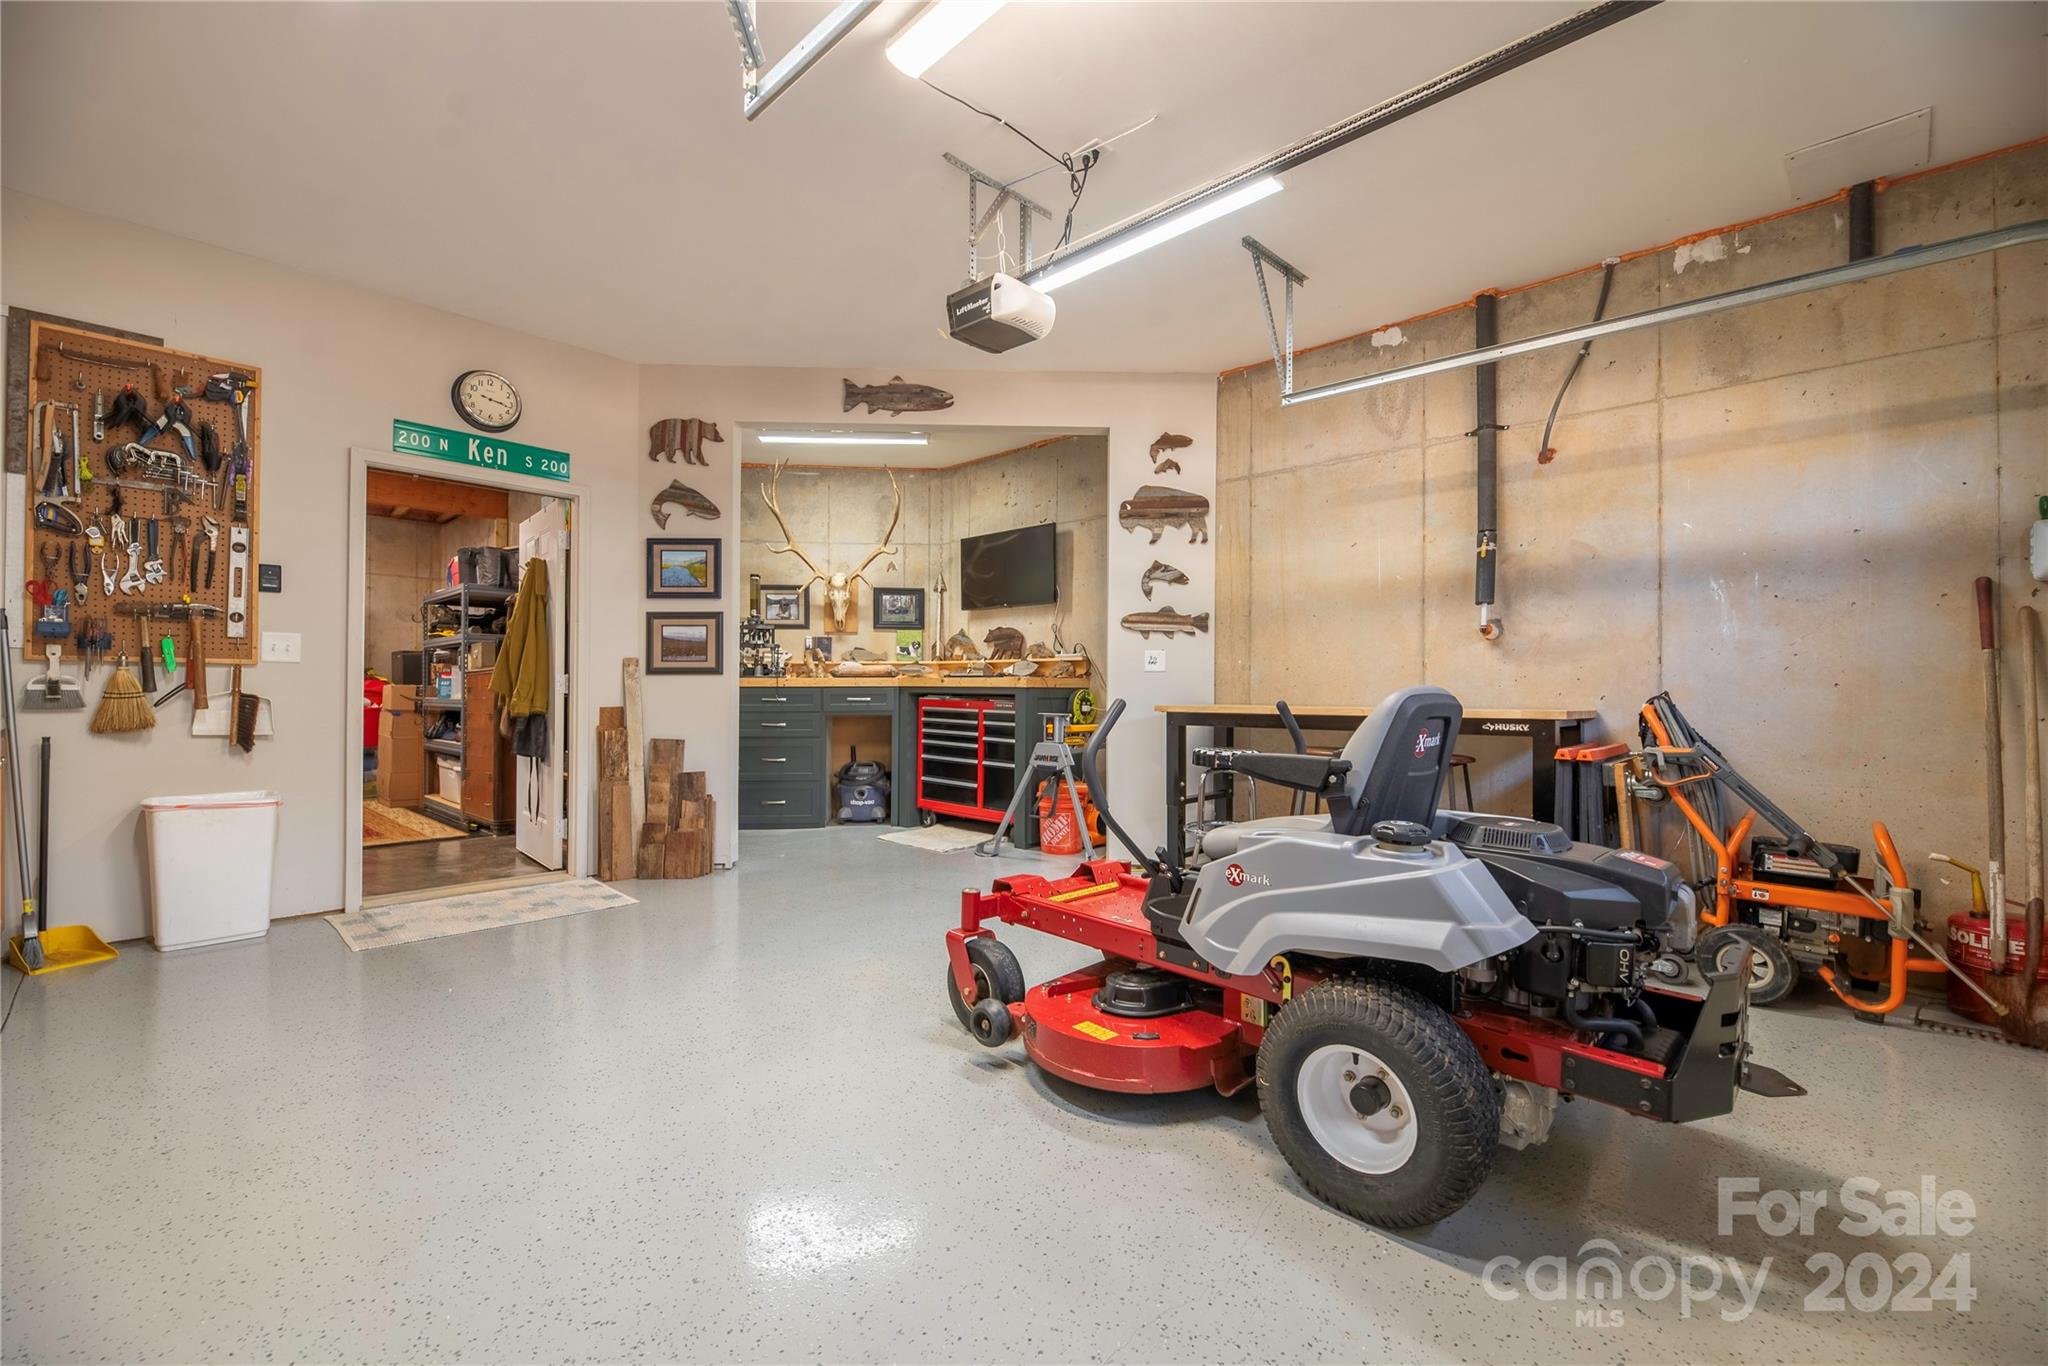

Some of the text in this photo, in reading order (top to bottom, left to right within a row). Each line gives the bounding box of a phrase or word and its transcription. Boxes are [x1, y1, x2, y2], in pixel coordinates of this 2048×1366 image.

[956, 297, 989, 316] LiftMaster
[398, 431, 568, 474] 200 N Ken S 200
[1494, 722, 1530, 732] HUSKY
[1950, 926, 2026, 957] SOLIE
[1619, 949, 1630, 984] OHV
